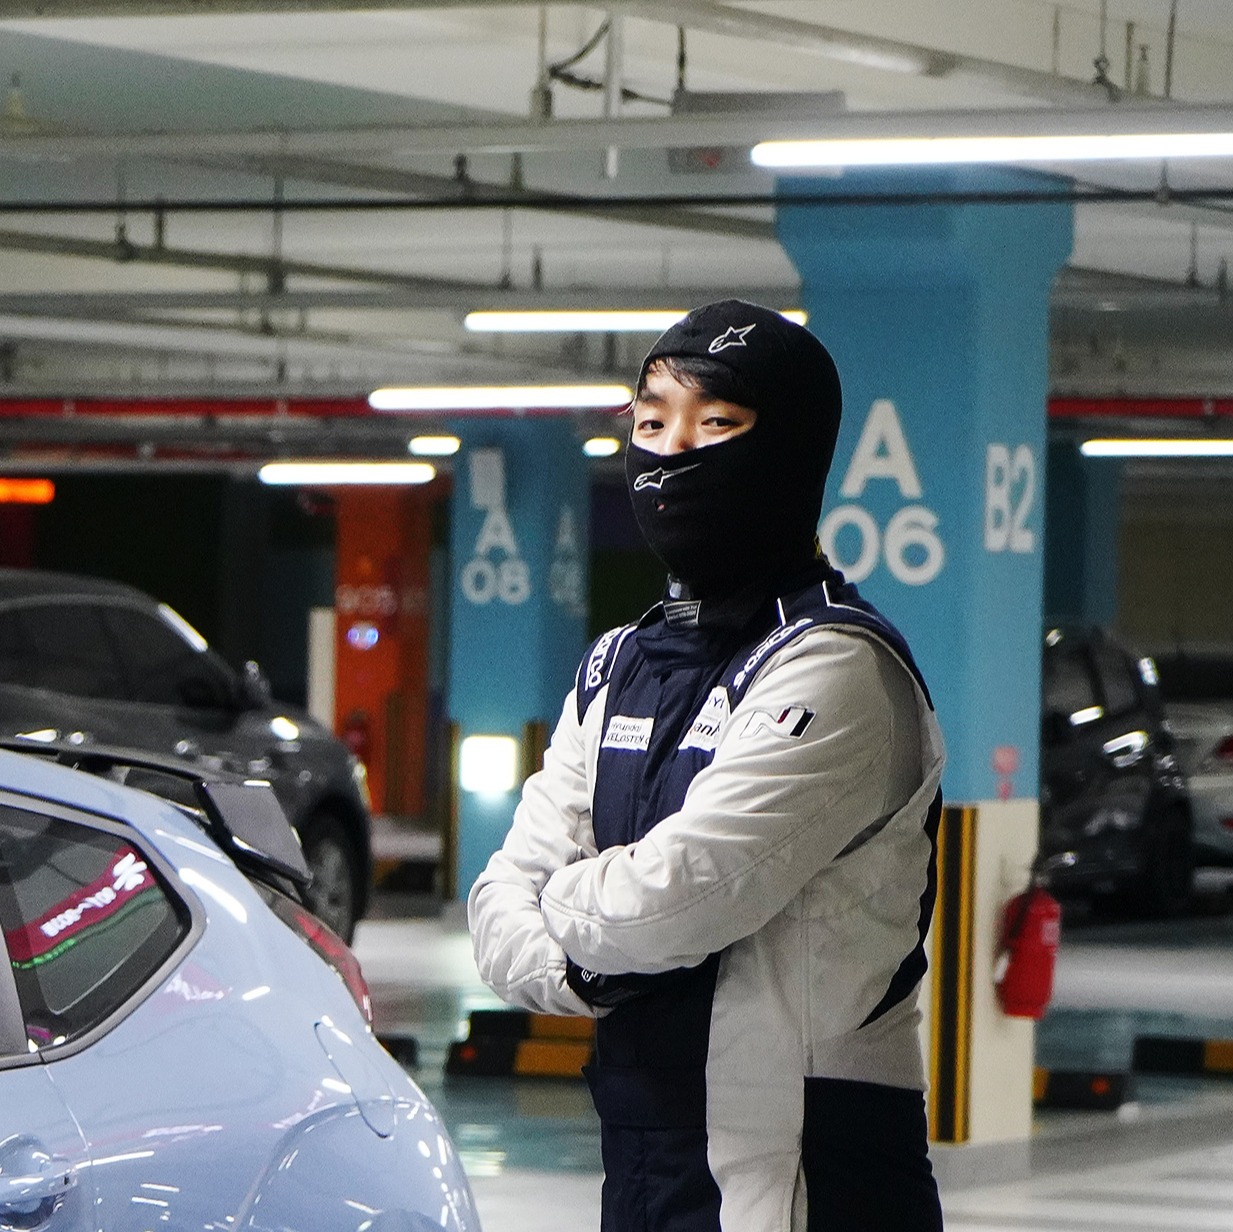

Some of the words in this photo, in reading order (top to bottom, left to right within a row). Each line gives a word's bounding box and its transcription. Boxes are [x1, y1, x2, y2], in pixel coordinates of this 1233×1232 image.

[838, 399, 922, 498] A
[474, 507, 518, 558] A
[984, 444, 1034, 552] B2
[461, 560, 532, 605] 08
[818, 505, 944, 586] 06
